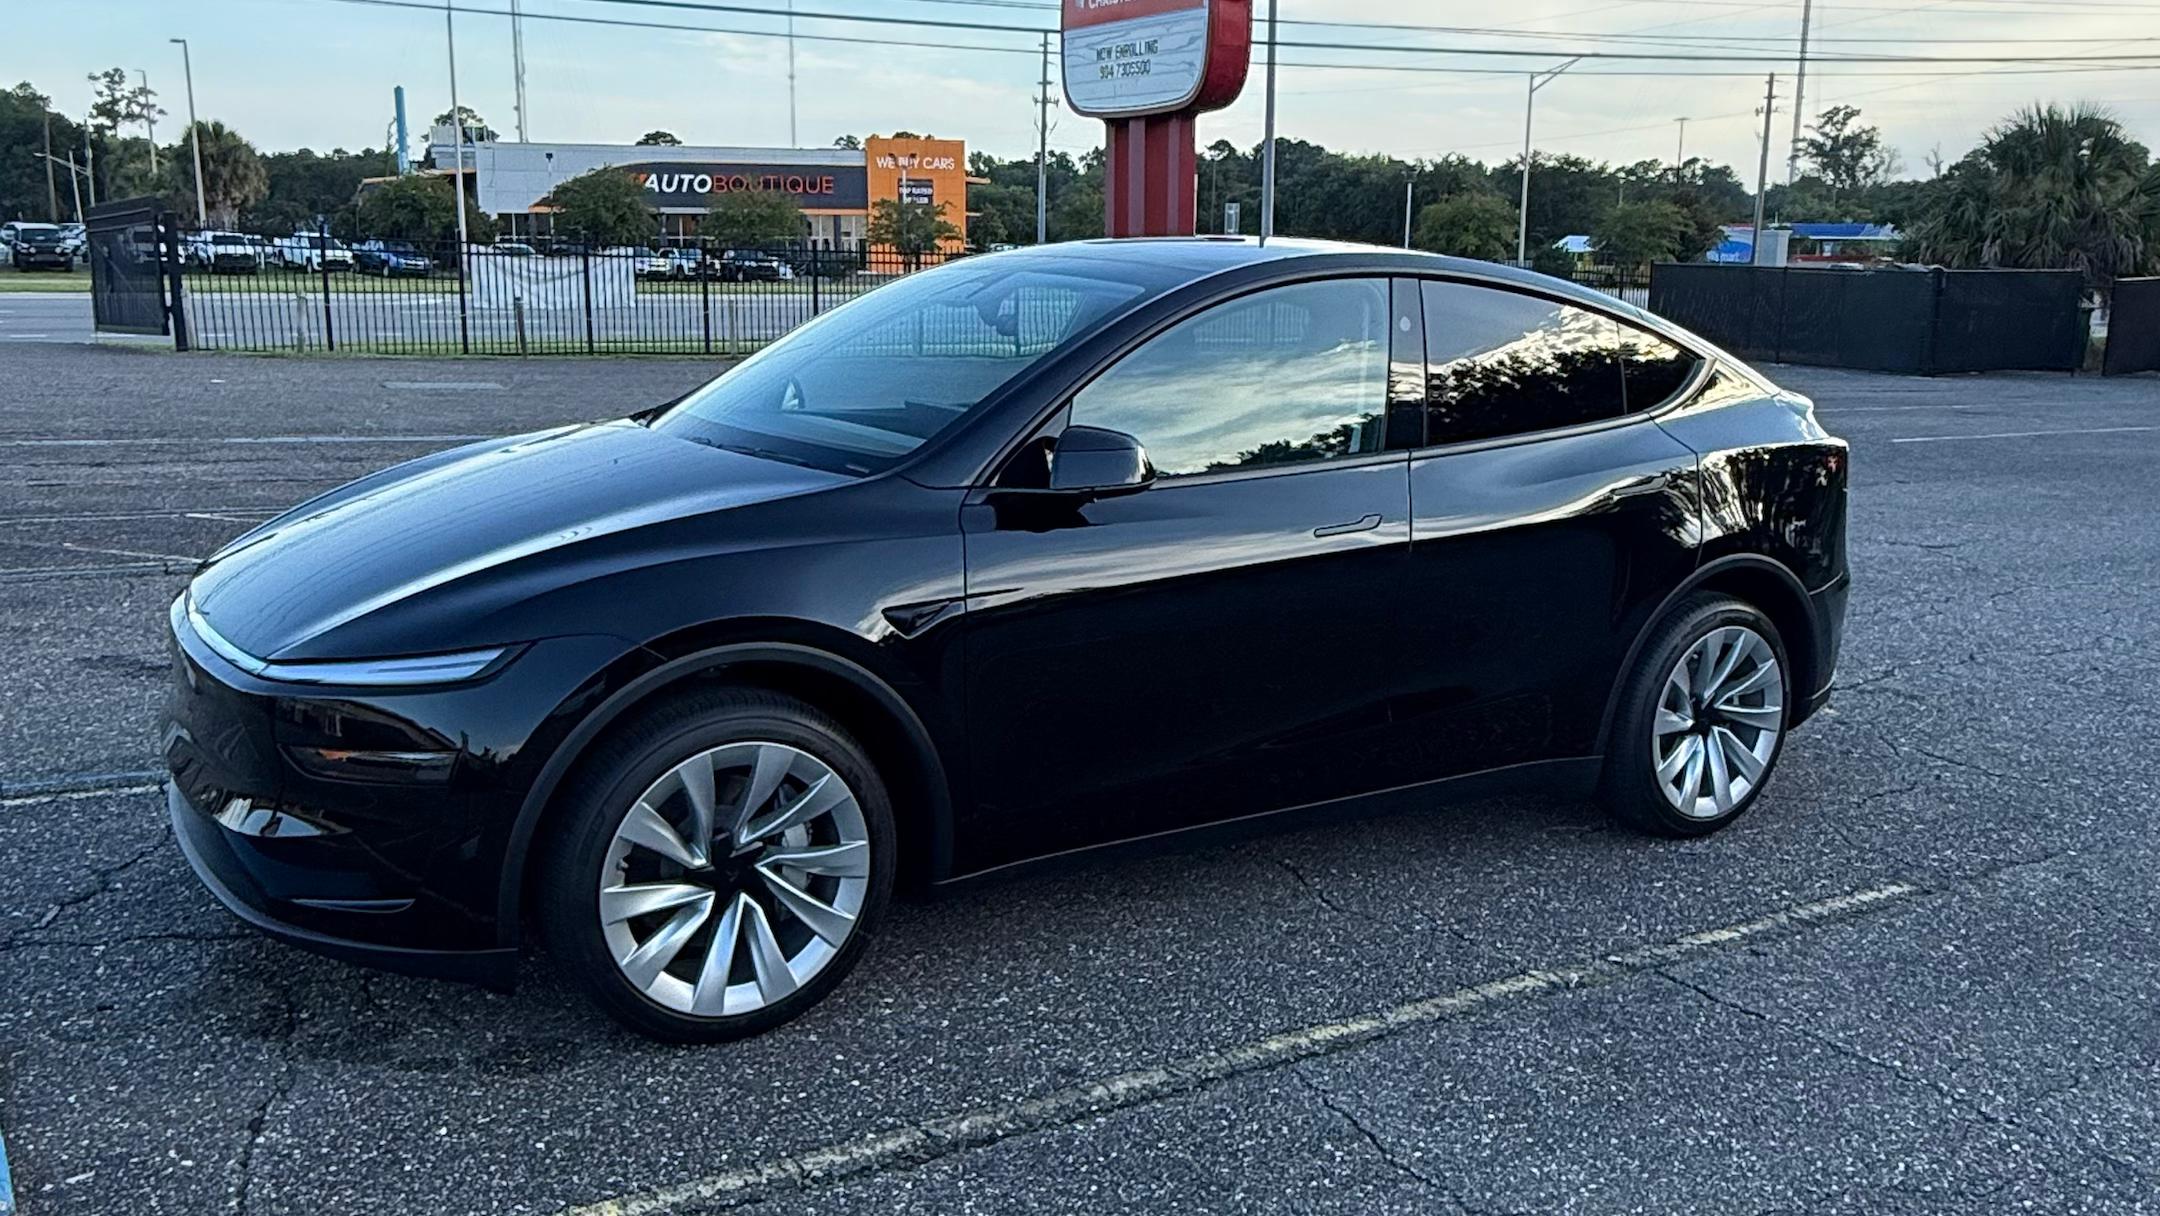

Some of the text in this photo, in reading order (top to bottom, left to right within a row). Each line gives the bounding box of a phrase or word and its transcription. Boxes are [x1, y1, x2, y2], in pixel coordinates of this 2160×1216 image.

[1096, 39, 1158, 61] NOW ENROLLING
[1100, 65, 1114, 80] 904
[876, 156, 896, 169] WE
[923, 156, 955, 170] CARS
